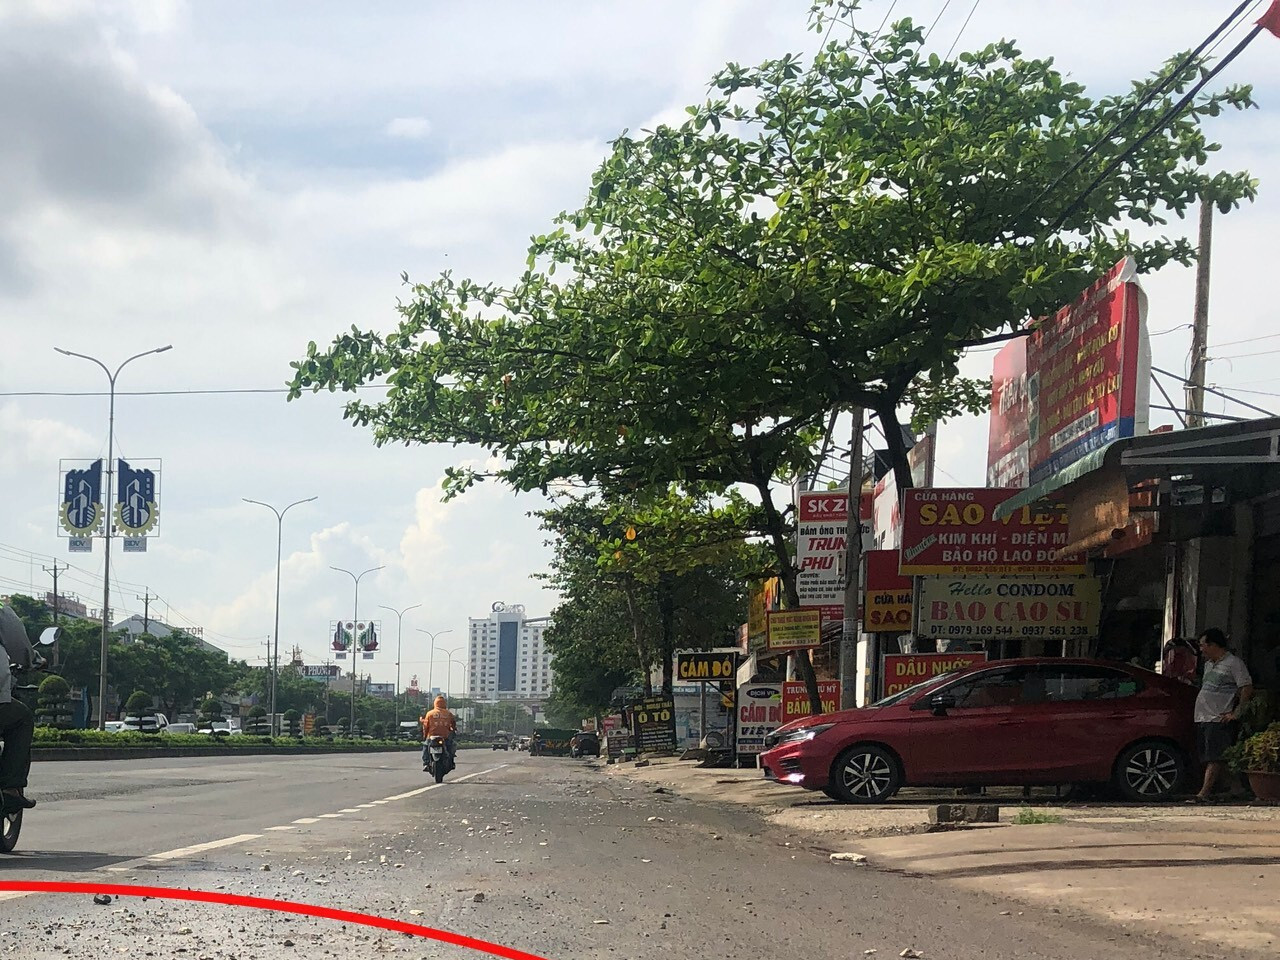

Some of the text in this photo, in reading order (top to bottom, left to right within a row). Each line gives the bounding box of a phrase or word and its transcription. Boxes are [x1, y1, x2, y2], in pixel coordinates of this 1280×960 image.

[942, 492, 974, 501] HÀNG
[808, 500, 829, 513] SK
[920, 503, 985, 526] SAO
[808, 537, 848, 551] TRUN
[938, 533, 966, 545] KIM
[971, 529, 996, 545] KHÍ
[1012, 530, 1047, 546] ĐIỆN
[800, 554, 835, 570] PHÚ
[942, 547, 972, 562] BẢO
[978, 548, 998, 564] HỘ
[1004, 551, 1032, 562] LAO
[949, 581, 1075, 596] Hello CONDOM
[871, 610, 912, 625] SAO
[931, 601, 1085, 622] BAO CAO SU
[949, 625, 972, 634] 0979
[976, 625, 993, 634] 169
[995, 625, 1013, 635] 544
[1022, 625, 1045, 635] 0937
[1049, 625, 1066, 634] 561
[896, 658, 927, 676] DẦU
[787, 686, 808, 694] TRUN
[787, 696, 811, 714] BẤM
[638, 709, 671, 723] Ô TÔ
